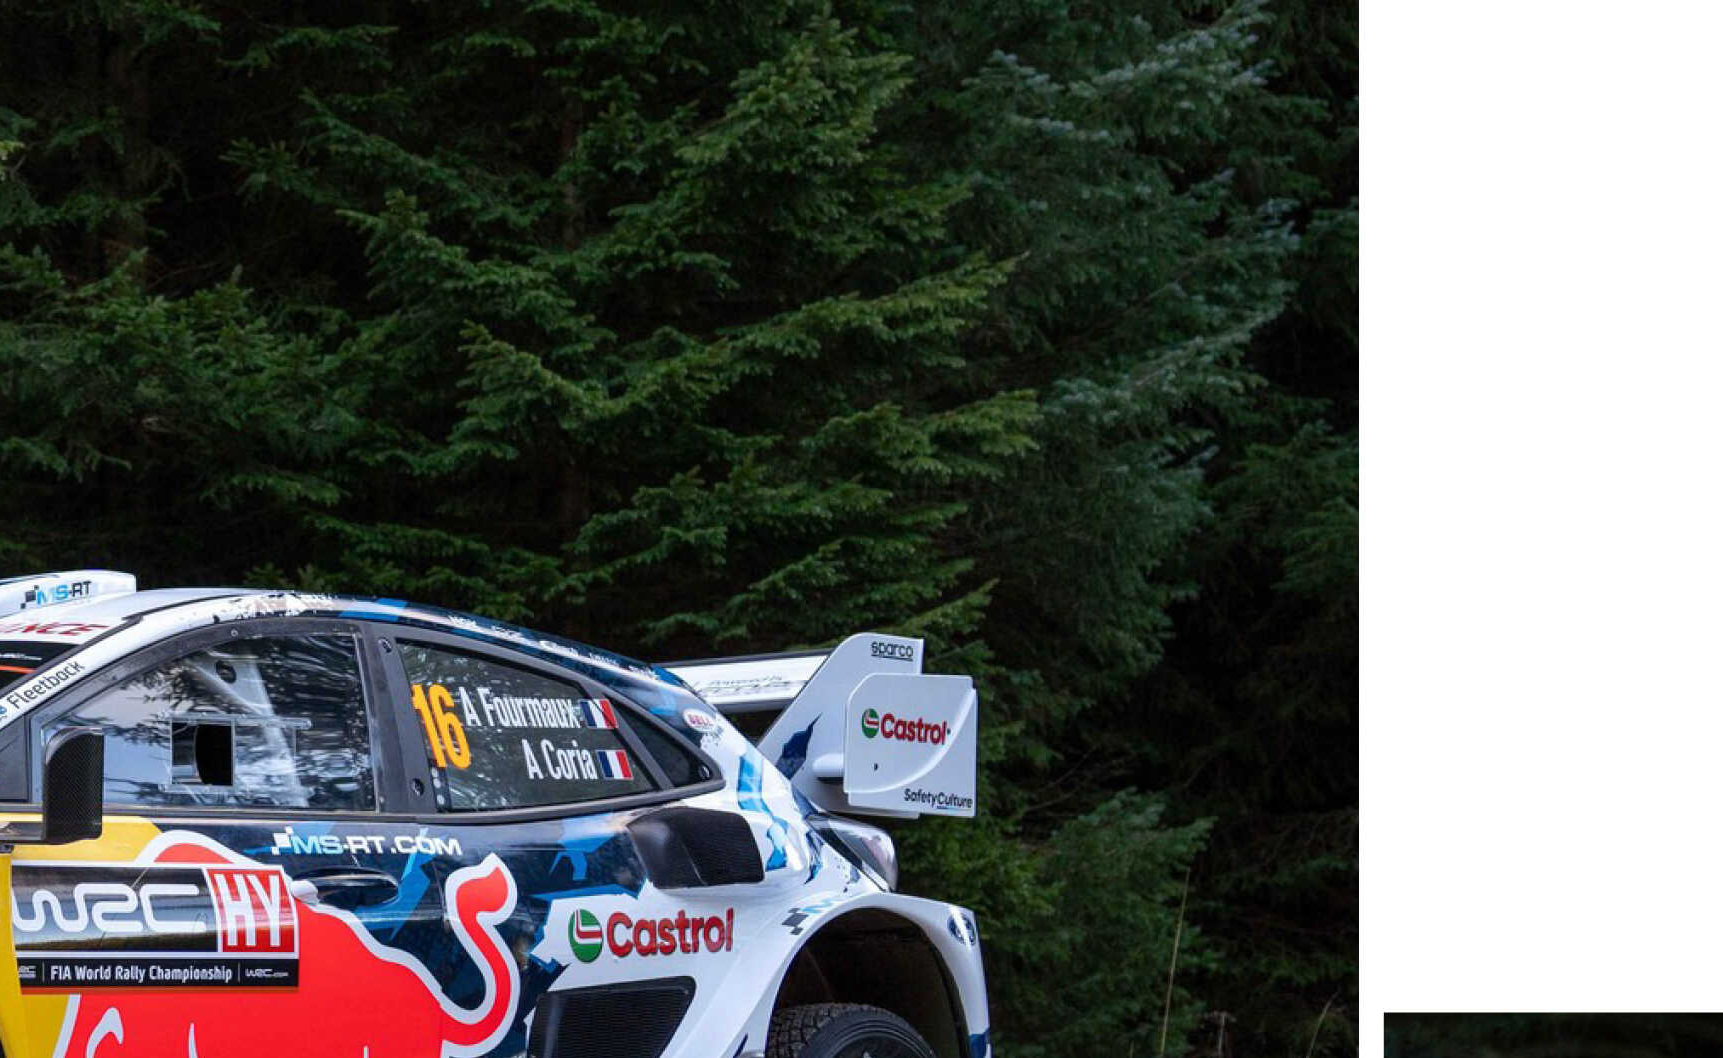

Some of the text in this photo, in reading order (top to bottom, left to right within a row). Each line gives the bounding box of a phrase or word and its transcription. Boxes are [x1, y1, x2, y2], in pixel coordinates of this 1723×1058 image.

[869, 641, 915, 660] sparco
[6, 661, 86, 710] Fleetback
[411, 683, 473, 770] 16
[457, 686, 582, 728] A Fourmaux
[880, 713, 948, 745] Castrol
[522, 739, 600, 780] A Coria
[214, 873, 281, 947] HY
[605, 906, 735, 957] Castrol
[50, 964, 72, 981] FIA
[75, 964, 111, 981] World
[114, 964, 146, 984] Rally
[148, 963, 233, 984] Championship
